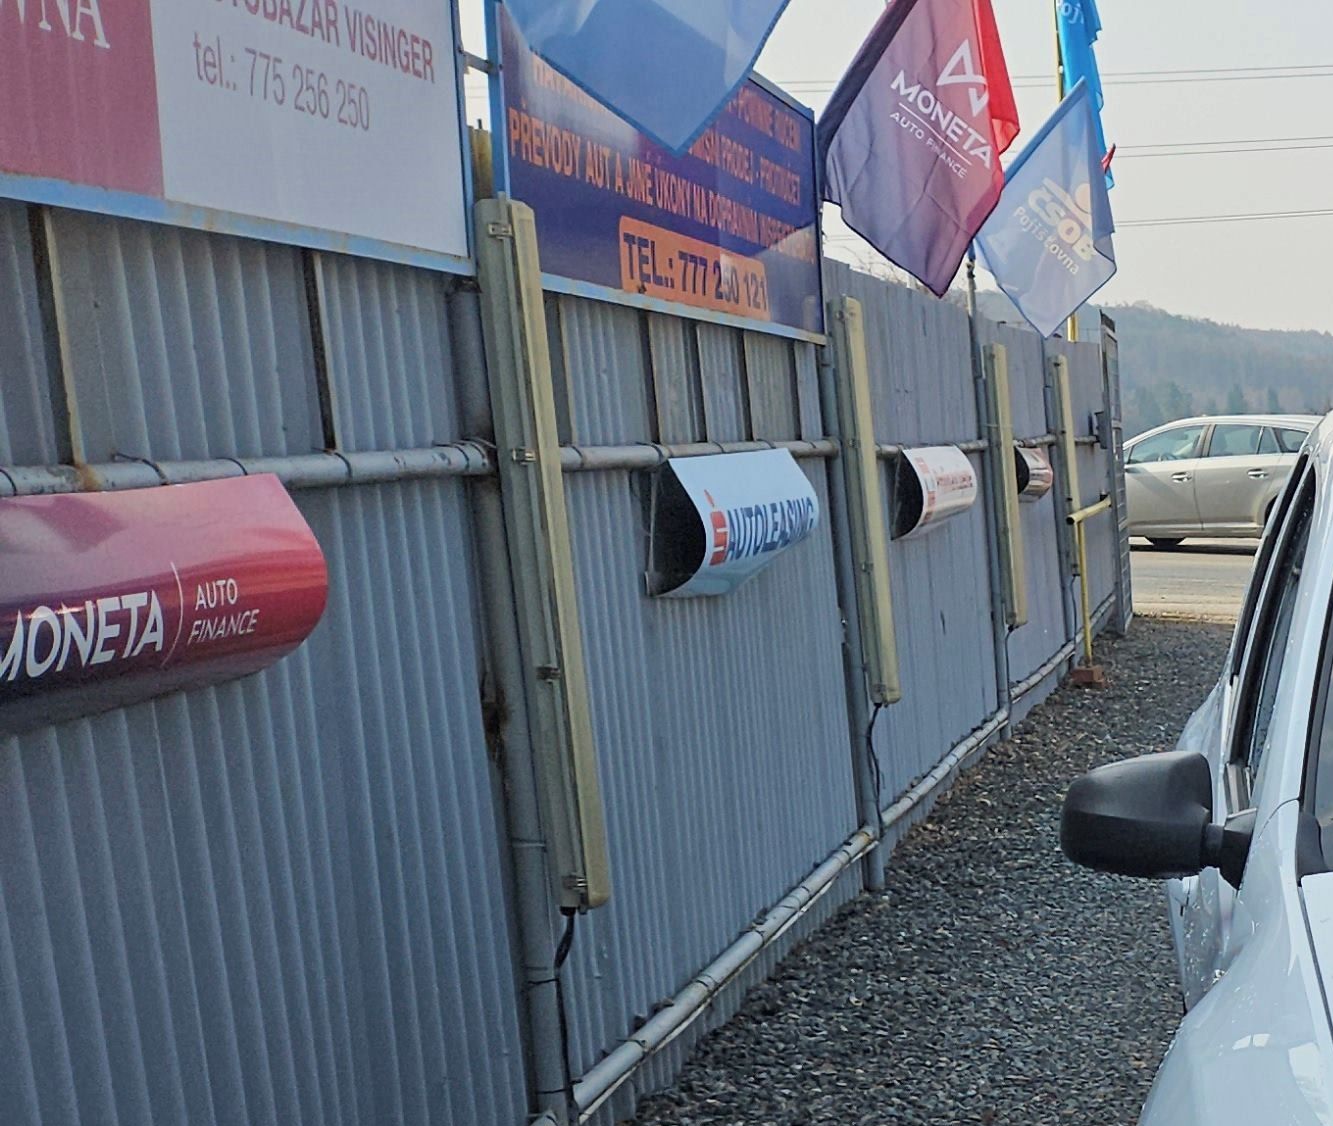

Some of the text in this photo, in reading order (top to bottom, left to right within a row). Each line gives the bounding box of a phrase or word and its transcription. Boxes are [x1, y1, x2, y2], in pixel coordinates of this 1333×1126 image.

[193, 31, 370, 131] tel.: 775 256 250
[344, 4, 435, 84] VISINGER
[508, 96, 581, 180] PŘEVODY
[585, 140, 611, 190] AUT
[615, 151, 624, 194] A
[889, 111, 925, 140] AUTO
[890, 69, 993, 170] MONETA
[623, 232, 768, 312] TEL.: 777 250 121
[187, 608, 260, 646] FINANCE
[195, 578, 238, 611] AUTO
